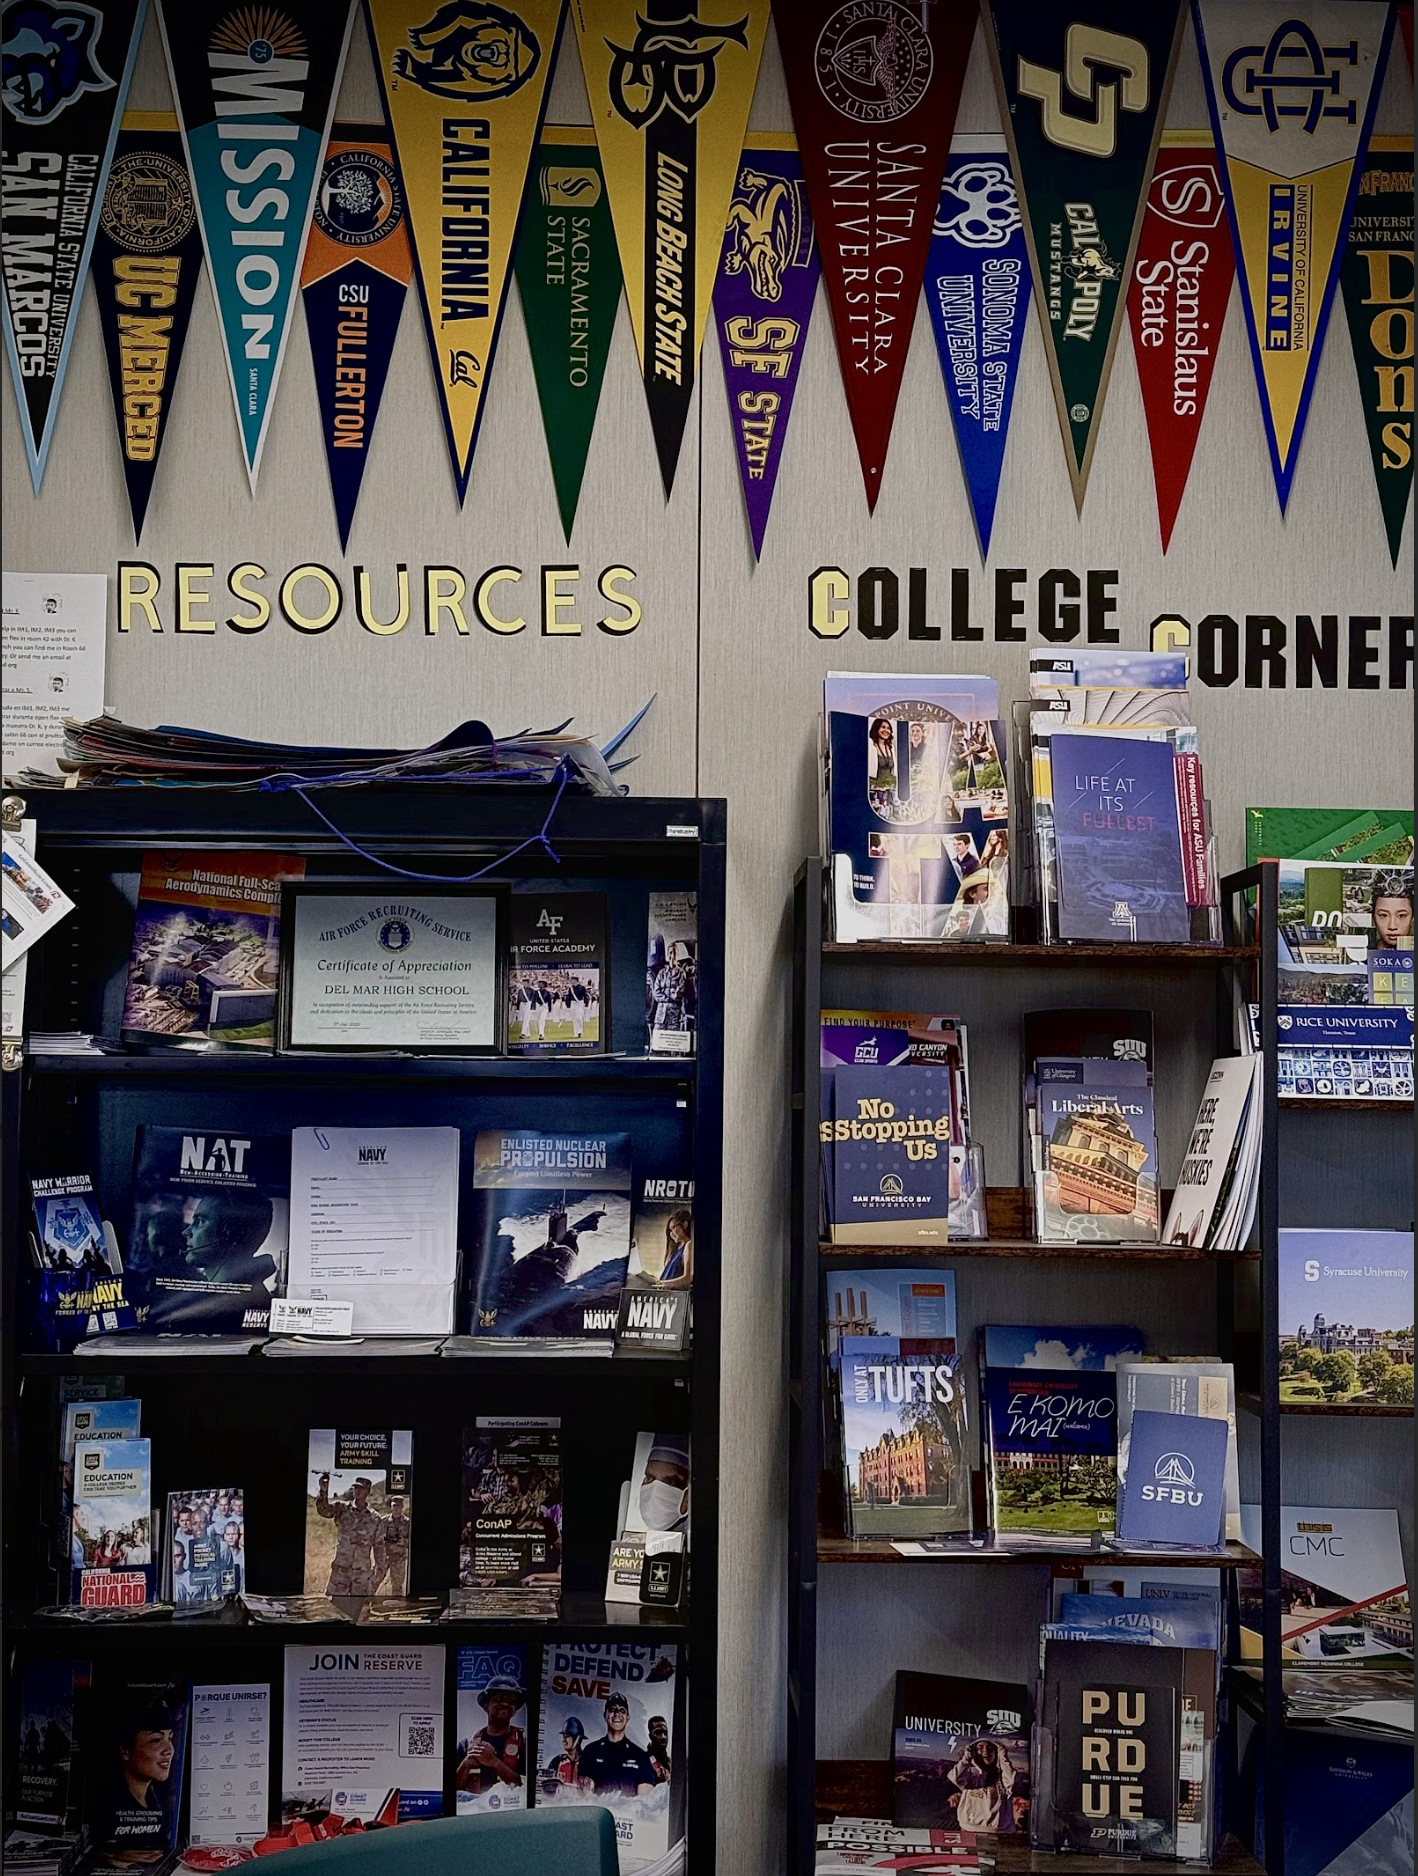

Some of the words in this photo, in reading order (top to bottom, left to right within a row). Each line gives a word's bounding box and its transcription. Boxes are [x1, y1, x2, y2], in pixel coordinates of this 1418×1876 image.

[2, 151, 62, 220] SAN
[60, 154, 99, 237] CALIFORNIA
[656, 151, 689, 223] LONG
[876, 141, 927, 248] SANTA
[207, 52, 309, 360] MISSION
[440, 118, 490, 322] CALIFORNIA
[1063, 202, 1101, 250] CAL
[1295, 185, 1308, 257] UNIVERSITY
[546, 215, 565, 285] STATE
[824, 139, 870, 375] UNIVERSITY
[54, 242, 80, 289] STATE
[656, 218, 688, 308] BEACH
[1050, 222, 1063, 321] MUSTANGS
[1270, 187, 1292, 349] IRVINE
[1295, 258, 1306, 276] OF
[112, 255, 182, 308] UC
[2, 233, 55, 378] MARCOS
[338, 284, 370, 304] CSU
[568, 217, 591, 388] SACRAMENTO
[1136, 259, 1168, 348] State
[982, 258, 1022, 358] SONOMA
[1062, 281, 1103, 343] POLY
[1293, 279, 1306, 352] CALIFORNIA
[873, 266, 904, 374] CLARA
[1170, 240, 1210, 416] Stanislaus
[46, 294, 71, 379] UNIVERSITY
[655, 302, 688, 387] STATE
[725, 316, 800, 379] SF
[936, 275, 981, 420] UNIVERSITY
[248, 367, 257, 389] SANTA
[333, 306, 367, 449] FULLERTON
[449, 348, 482, 389] Cal
[117, 315, 172, 462] MERCED
[982, 361, 1008, 432] STATE
[248, 390, 256, 416] CLARA
[738, 391, 782, 480] STATE
[117, 560, 642, 637] RESOURCES
[808, 565, 1120, 644] COLLEGE
[1150, 613, 1415, 690] CORNER
[1052, 661, 1072, 671] ASU
[1049, 701, 1068, 711] ASU
[1187, 757, 1196, 774] Key
[1075, 775, 1110, 791] LIFE
[1114, 777, 1136, 793] AT
[1099, 795, 1124, 812] ITS
[1188, 775, 1199, 818] resources
[1082, 812, 1156, 832] FULLEST
[1192, 819, 1201, 832] for
[1194, 832, 1204, 852] ASU
[192, 869, 237, 887] National
[238, 875, 281, 892] Full-Sca
[1195, 854, 1206, 890] Families
[165, 877, 242, 899] Aerodynamics
[319, 930, 337, 943] AIR
[338, 915, 368, 939] FORCE
[367, 905, 433, 929] RECRUITING
[431, 921, 472, 942] SERVICE
[520, 945, 551, 954] FORCE
[552, 944, 596, 953] ACADEMY
[317, 959, 378, 975] Certificate
[382, 959, 396, 976] of
[398, 959, 472, 974] Appreciation
[325, 985, 350, 995] DEL
[353, 985, 379, 995] MAR
[383, 985, 414, 995] HIGH
[418, 985, 469, 996] SCHOOL
[824, 1017, 845, 1026] FIND
[848, 1018, 870, 1028] YOUR
[873, 1019, 913, 1029] PURPOSE
[1296, 1017, 1324, 1027] RICE
[1325, 1018, 1398, 1028] UNIVERSITY
[855, 1046, 879, 1059] GCU
[919, 1043, 948, 1052] CANYON
[857, 1098, 895, 1120] No
[1051, 1100, 1107, 1114] Liberal
[1109, 1103, 1144, 1116] Arts
[1090, 1094, 1118, 1102] Classical
[835, 1115, 950, 1144] Stopping
[180, 1136, 251, 1174] NAT
[359, 1148, 386, 1162] NAVY
[501, 1139, 553, 1151] ENLISTED
[555, 1140, 607, 1152] NUCLEAR
[903, 1139, 938, 1161] Us
[500, 1151, 607, 1169] PROPULSION
[513, 1169, 540, 1178] Forging
[1178, 1159, 1213, 1186] HUSKIES
[65, 1184, 93, 1195] PROGRAM
[1304, 1260, 1320, 1282] S
[1323, 1265, 1362, 1278] Syracuse
[1364, 1266, 1409, 1280] University
[583, 1313, 618, 1330] NAVY
[627, 1302, 678, 1329] NAVY
[64, 1388, 99, 1397] SERVICE
[868, 1365, 954, 1404] TUFTS
[1007, 1393, 1028, 1415] E
[1029, 1394, 1115, 1419] KOMO
[74, 1431, 123, 1441] EDUCATION
[340, 1433, 360, 1441] YOUR
[360, 1434, 388, 1442] CHOICE,
[1008, 1415, 1067, 1438] MAI
[84, 1472, 133, 1483] EDUCATION
[1141, 1485, 1204, 1507] SFBU
[475, 1518, 513, 1530] ConAP
[526, 1533, 547, 1541] Program
[1289, 1535, 1346, 1557] CMC
[611, 1559, 640, 1570] ARMY
[82, 1572, 132, 1587] NATIONAL
[81, 1584, 146, 1607] GUARD
[309, 1654, 359, 1671] JOIN
[363, 1660, 423, 1671] RESERVE
[458, 1655, 522, 1680] FAQ
[554, 1652, 645, 1682] DEFEND
[552, 1675, 611, 1701] SAVE
[1082, 1690, 1146, 1727] PU
[905, 1715, 982, 1738] UNIVERSITY
[1082, 1736, 1146, 1774] RD
[22, 1775, 59, 1787] RECOVERY.
[21, 1788, 32, 1796] OUR
[32, 1789, 53, 1798] PURPOSE
[1082, 1783, 1144, 1820] UE
[114, 1826, 132, 1836] FOR
[131, 1823, 162, 1835] WOMEN
[828, 1826, 906, 1836] FROM
[828, 1833, 898, 1842] HERE
[1107, 1829, 1137, 1837] PURDUE
[828, 1841, 968, 1855] POSSIBLE
